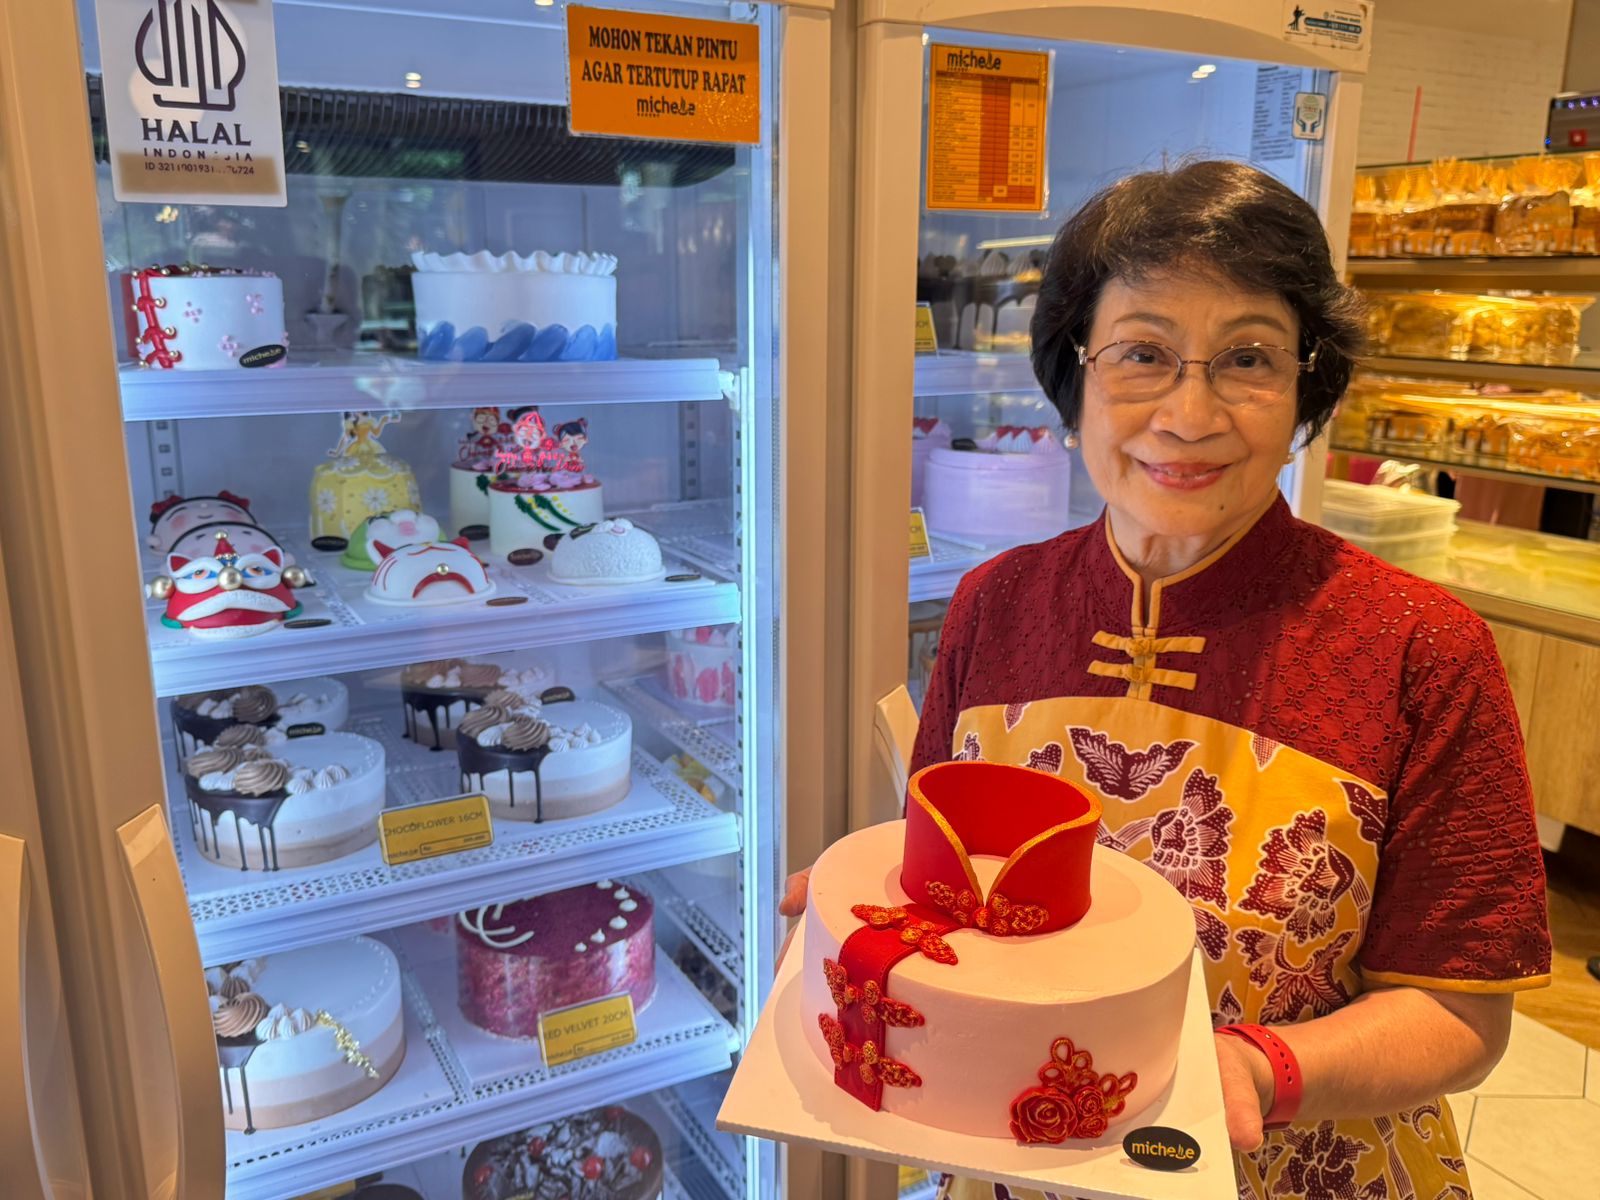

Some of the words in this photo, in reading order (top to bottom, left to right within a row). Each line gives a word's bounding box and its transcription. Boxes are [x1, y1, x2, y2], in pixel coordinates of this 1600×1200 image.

[589, 25, 641, 51] MOHON
[645, 32, 693, 56] TEKAN
[697, 38, 738, 60] PINTU
[582, 59, 623, 84] AGAR
[627, 64, 699, 90] TERTUTUP
[703, 71, 746, 95] RAPAT
[637, 96, 696, 116] michelle
[141, 118, 251, 146] HALAL
[144, 148, 253, 161] INDONIA
[145, 162, 155, 171] ID
[458, 811, 483, 824] 16CM
[564, 1017, 599, 1035] VELVET
[602, 1008, 628, 1025] 20CM
[1132, 1141, 1195, 1160] michelle
